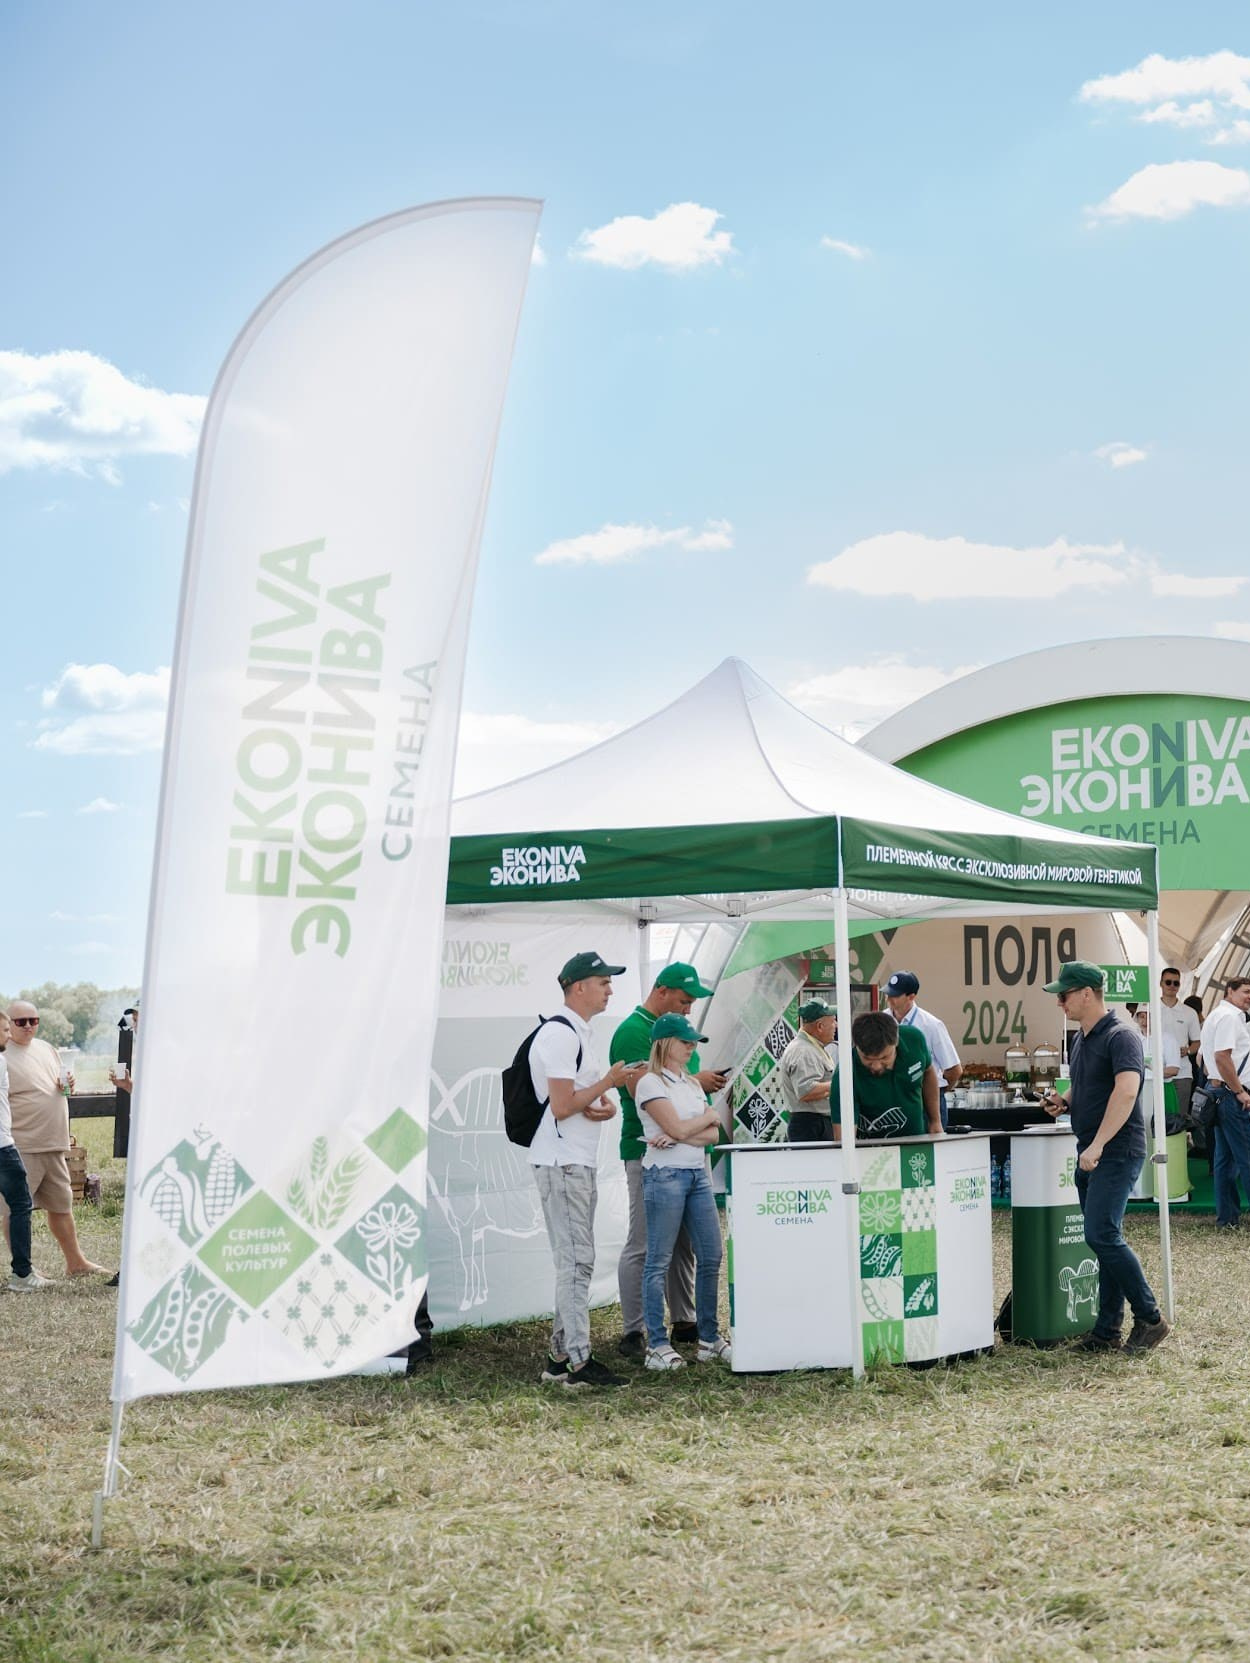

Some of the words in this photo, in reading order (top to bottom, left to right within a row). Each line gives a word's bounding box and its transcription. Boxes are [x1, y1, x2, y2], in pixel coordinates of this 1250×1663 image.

[225, 537, 326, 897] EKONIVA
[290, 572, 392, 958] ЭКОНИВА
[381, 659, 438, 862] СЕМЕНА
[1020, 762, 1250, 817] ЭКОНИВА
[502, 845, 587, 867] EKONIVA
[866, 844, 937, 869] ПЛЕМЕННОЙ
[935, 854, 957, 872] КРС
[965, 858, 1047, 881] ЭКСКЛЮЗИВНОЙ
[1047, 865, 1094, 883] МИРОВОЙ
[1093, 868, 1143, 885] ГЕНЕТИКОЙ
[490, 864, 581, 887] ЭКОНИВА
[962, 1000, 1027, 1045] 2024
[766, 1189, 833, 1203] EKONIVA
[756, 1202, 828, 1215] ЭКОНИВА
[774, 1217, 814, 1225] СЕМЕНА
[228, 1227, 286, 1241] СЕМЕНА
[222, 1241, 292, 1257] ПОЛЕВЫХ
[225, 1257, 288, 1272] КУЛЬТУР
